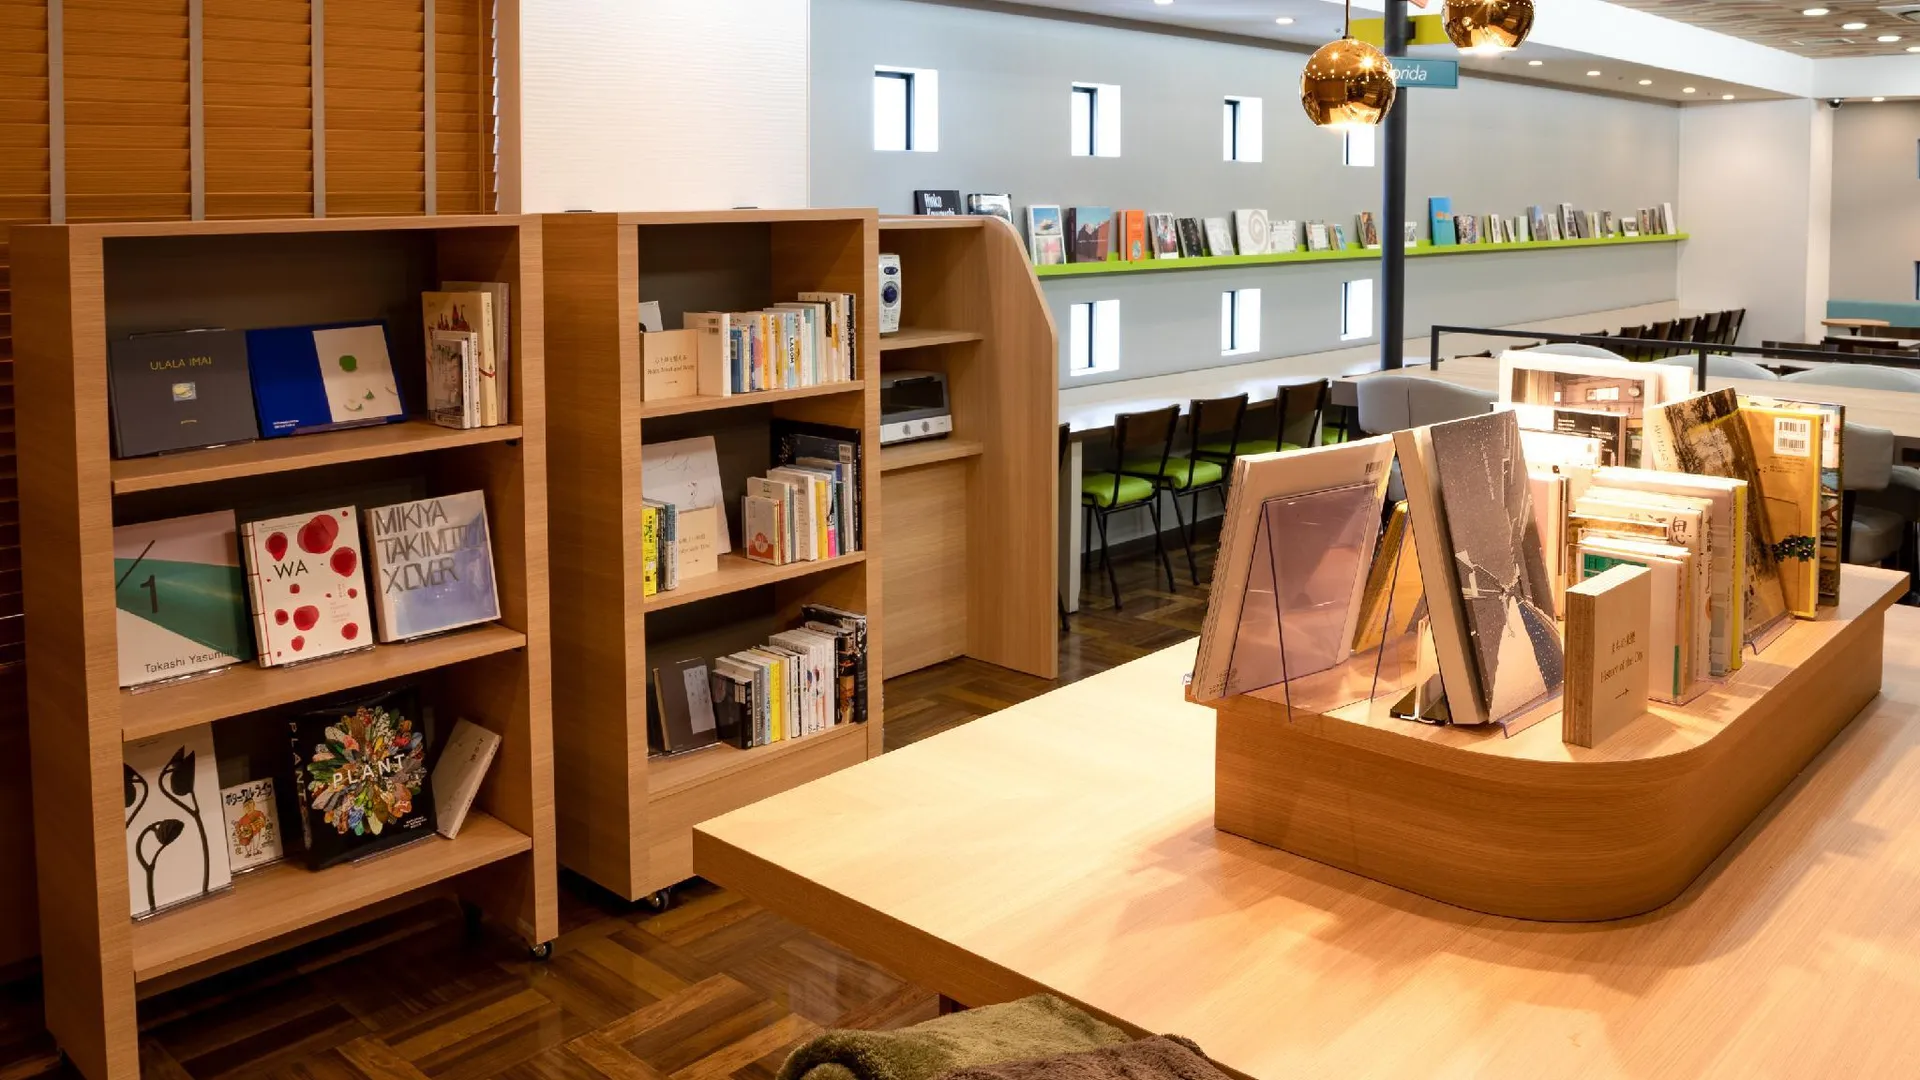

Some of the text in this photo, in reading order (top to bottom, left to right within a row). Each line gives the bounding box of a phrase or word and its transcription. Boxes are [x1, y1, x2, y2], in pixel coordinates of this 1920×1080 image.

[1392, 64, 1427, 82] orida
[924, 193, 943, 208] Rinko
[150, 355, 212, 371] ULALA IMAI
[375, 500, 448, 536] MIKIYA
[273, 560, 309, 580] WA
[144, 658, 185, 674] Takashi
[1600, 665, 1618, 684] History
[289, 721, 308, 802] PLANT
[332, 752, 406, 789] PLANT
